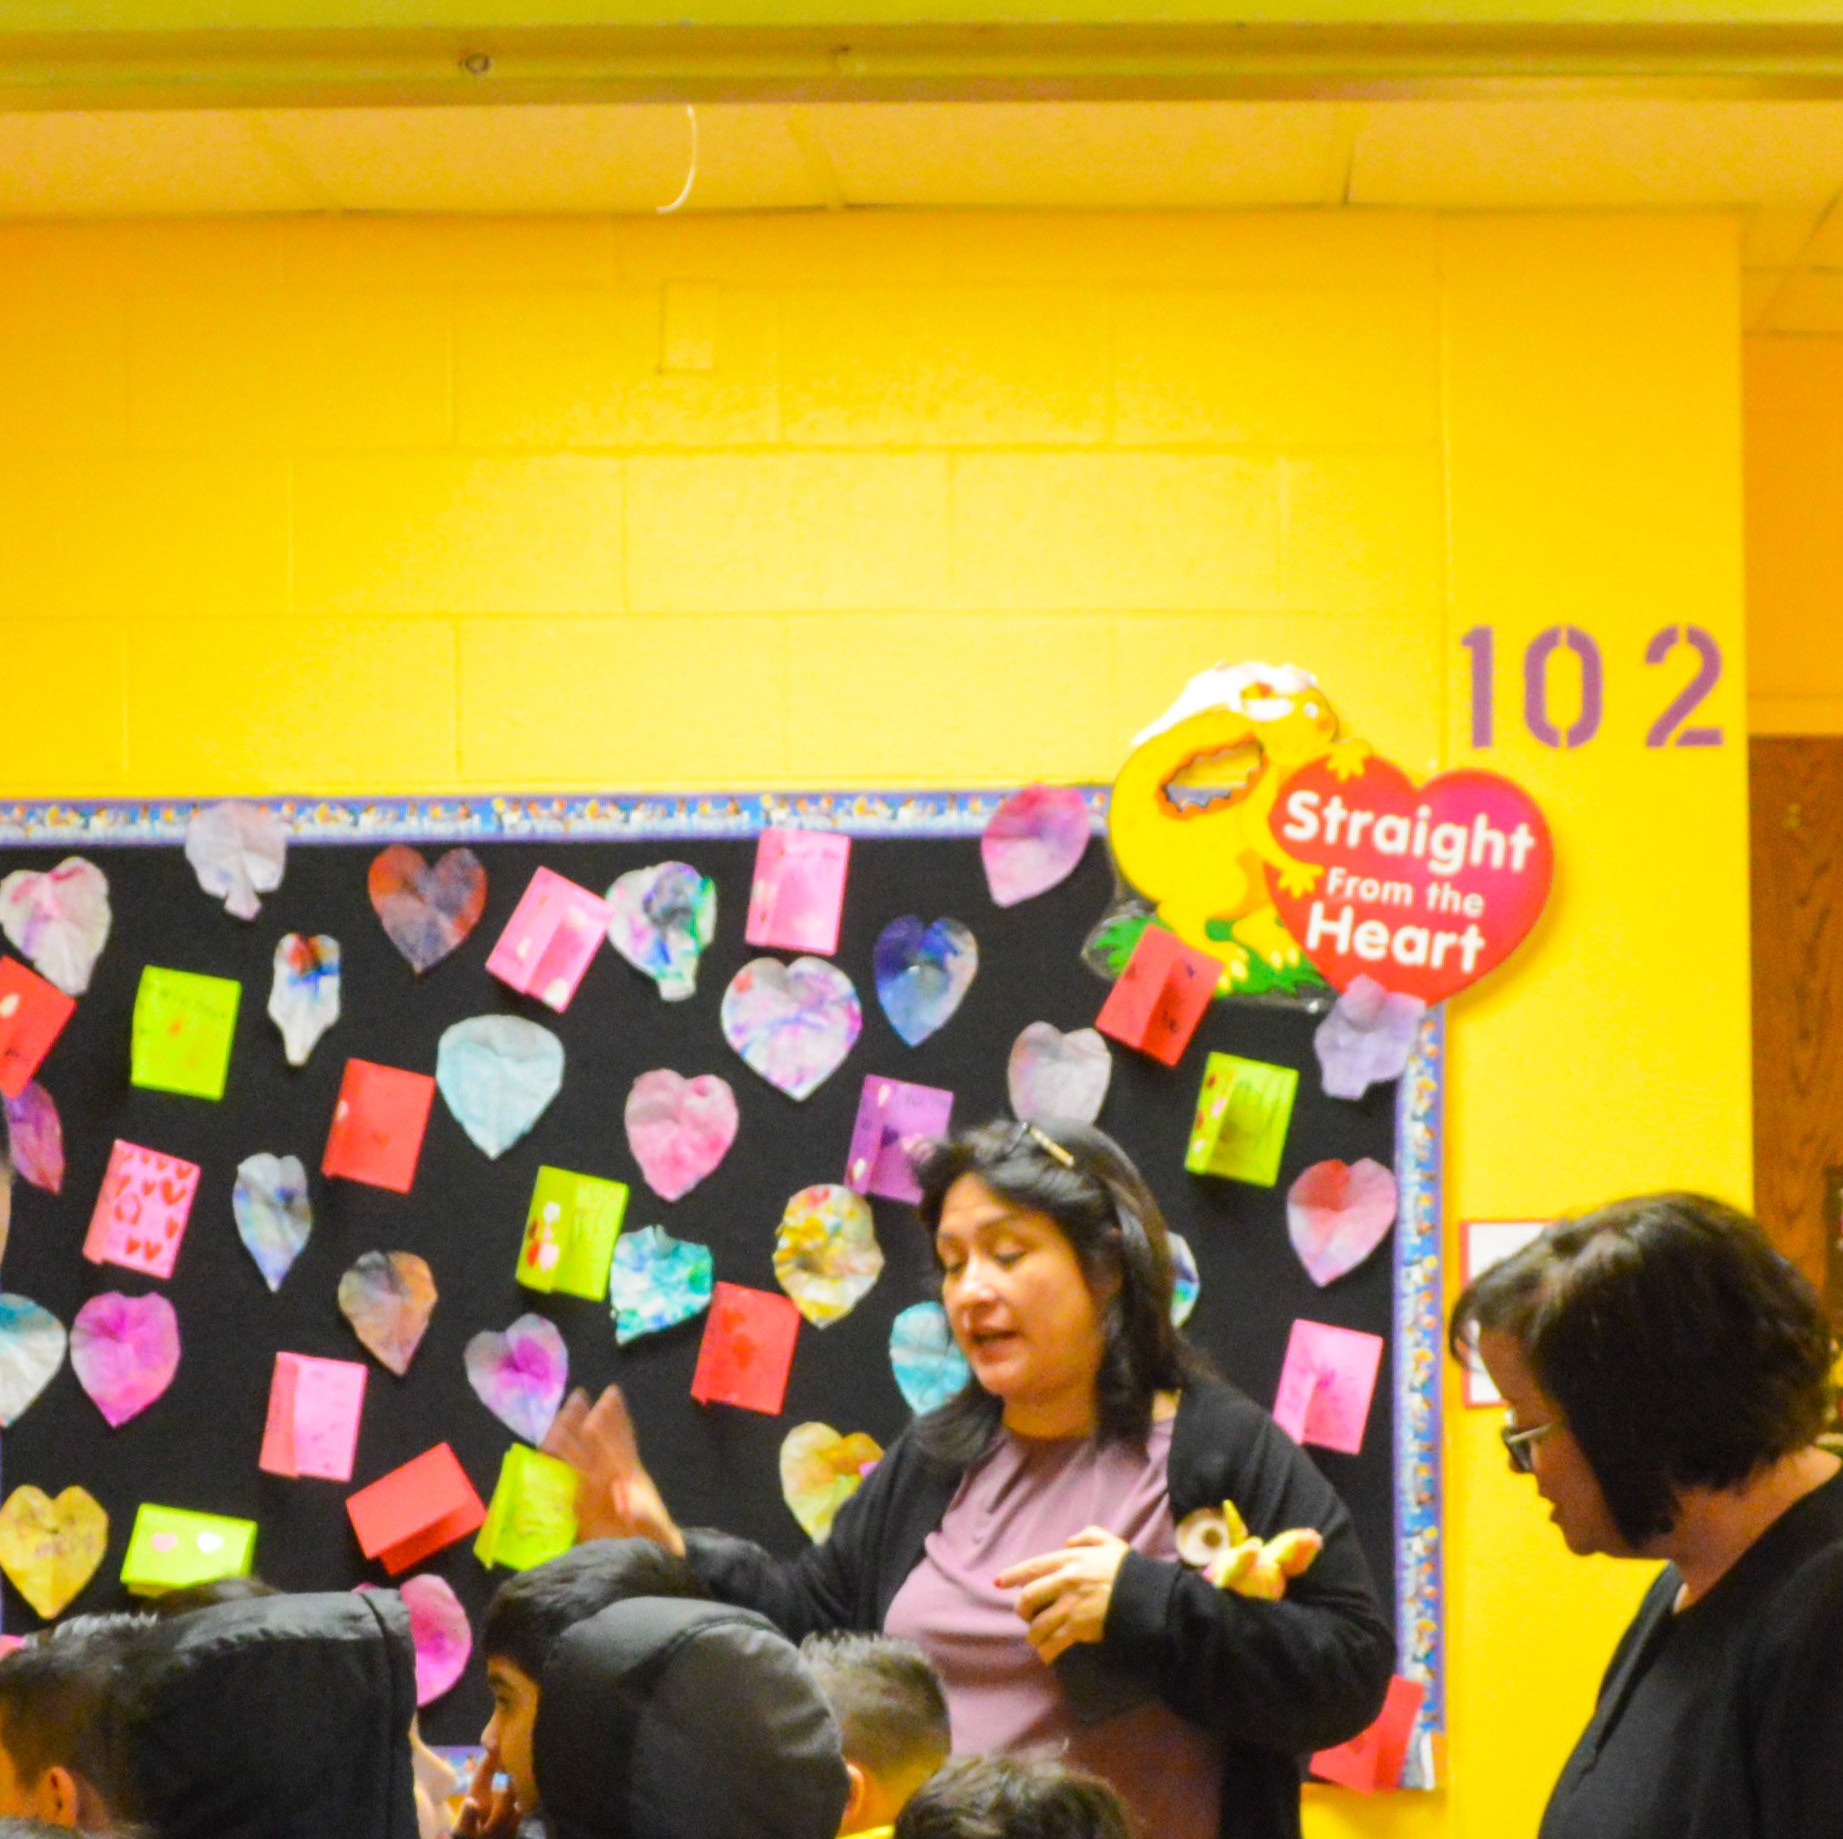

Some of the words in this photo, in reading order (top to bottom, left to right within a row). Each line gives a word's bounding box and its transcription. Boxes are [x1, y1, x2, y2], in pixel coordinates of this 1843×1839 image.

[1461, 624, 1724, 750] 102
[1283, 790, 1536, 875] Straight
[1326, 866, 1413, 908] From
[1424, 881, 1485, 918] the
[1305, 902, 1486, 973] Heart
